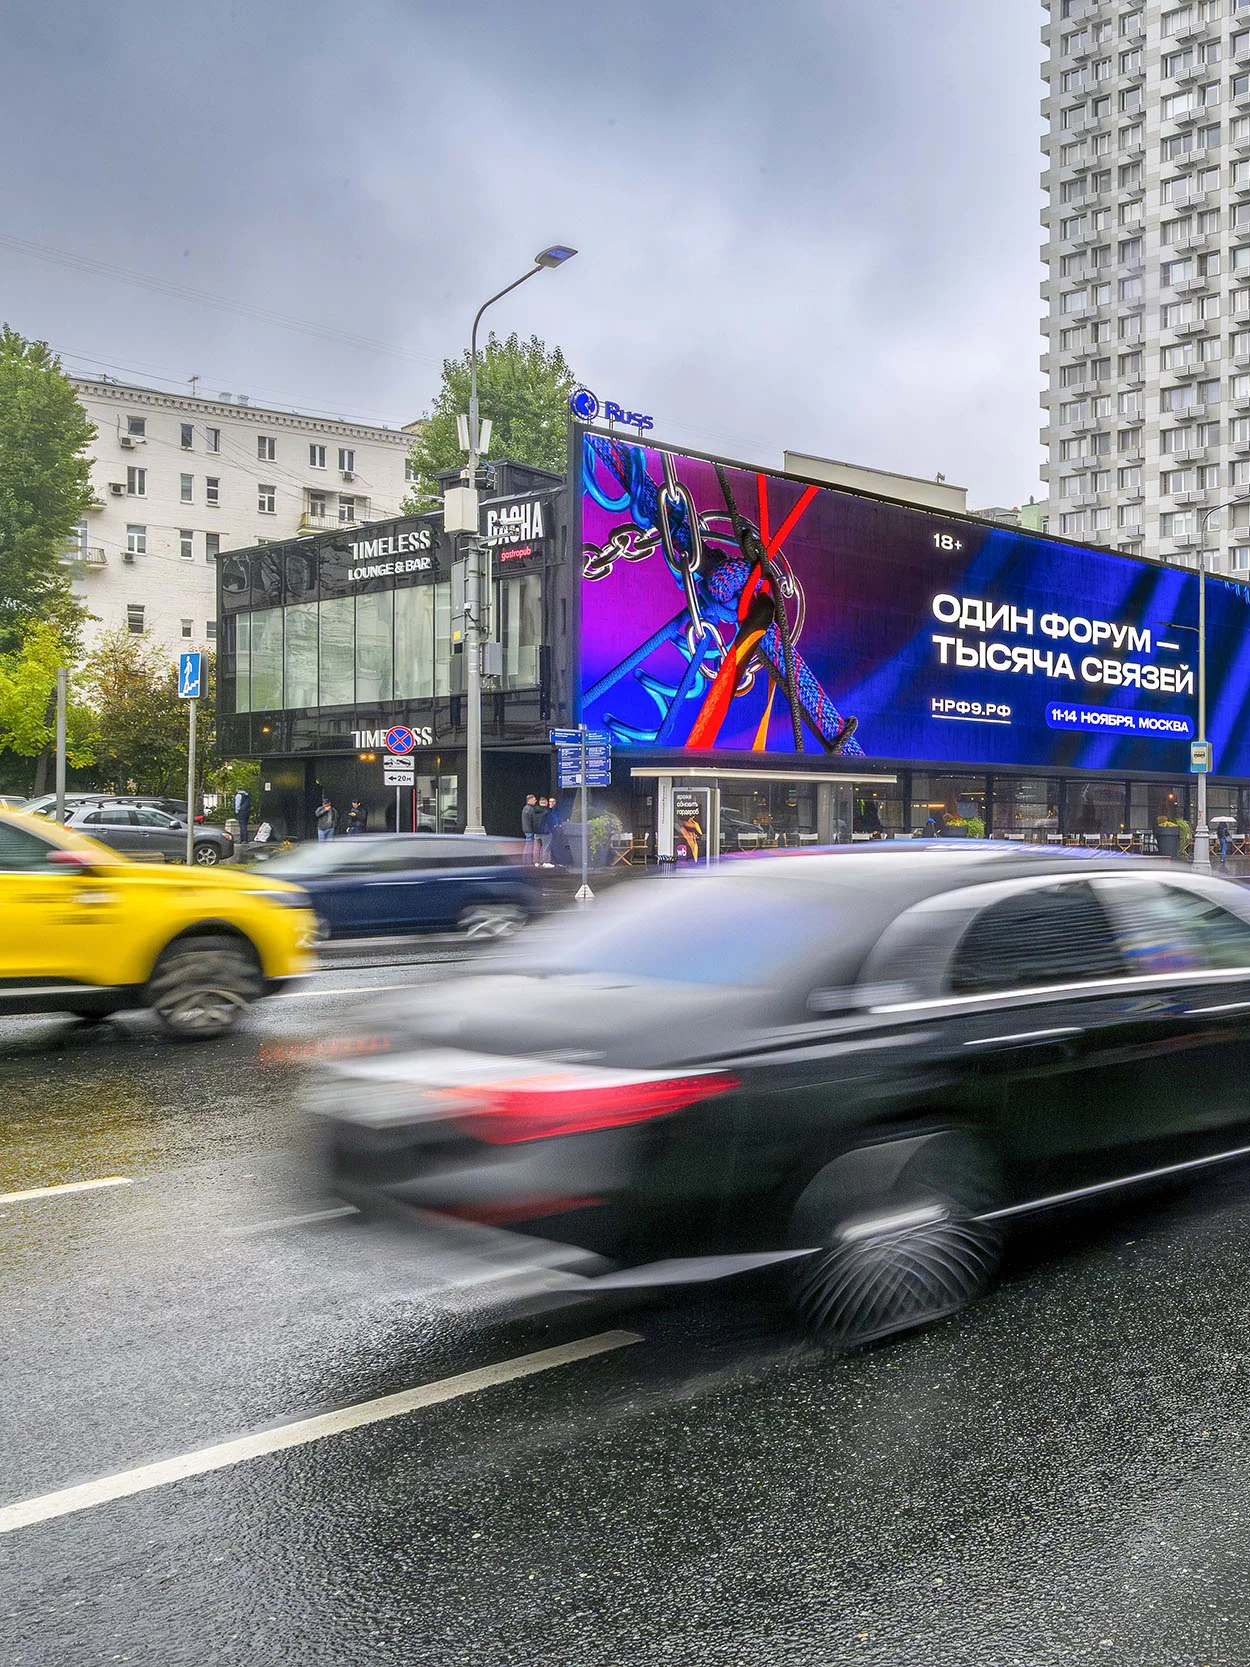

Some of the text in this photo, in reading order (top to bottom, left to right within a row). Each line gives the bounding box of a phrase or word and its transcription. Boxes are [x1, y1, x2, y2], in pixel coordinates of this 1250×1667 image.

[605, 400, 654, 430] Russ
[348, 529, 431, 560] TIMELESS
[501, 546, 531, 561] gastropub
[933, 532, 963, 550] 18+
[932, 593, 1034, 635] ОДИН
[1040, 612, 1151, 653] ФОРУМ
[932, 634, 1194, 695] ТЫСЯЧА СВЯЗЕЙ
[931, 698, 1011, 717] НРФ9.РФ
[1051, 708, 1189, 733] 11-14 НОЯБРЯ, МОСКВА
[350, 727, 433, 748] TIMESS
